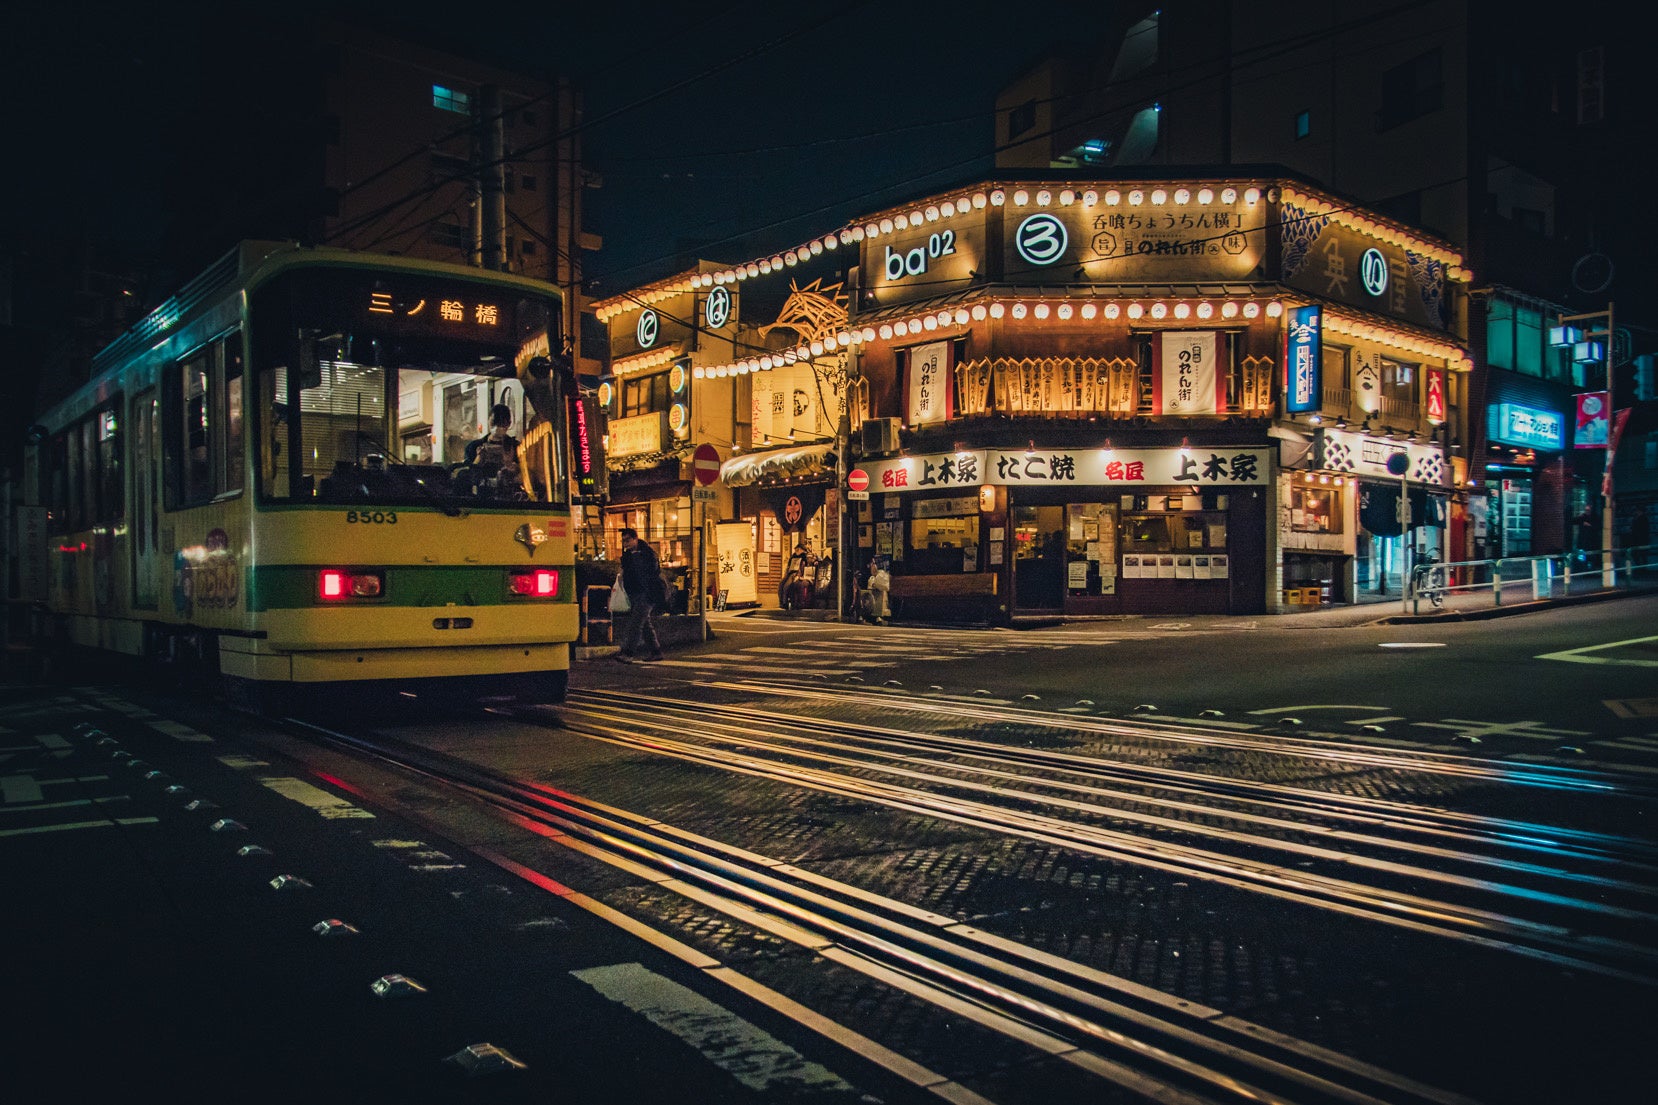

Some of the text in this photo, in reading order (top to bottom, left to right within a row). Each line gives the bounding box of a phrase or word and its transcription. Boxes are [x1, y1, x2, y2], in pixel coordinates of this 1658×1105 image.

[1023, 220, 1059, 252] ろ
[1138, 240, 1206, 255] のれん街
[369, 293, 498, 325] 三ノ輪橋
[709, 292, 727, 322] は
[919, 362, 931, 411] のれん街
[1178, 350, 1193, 402] のれん街
[882, 454, 978, 488] 名匠 上木家
[997, 453, 1258, 482] たこ焼 名匠 上木家
[347, 510, 398, 525] 8503
